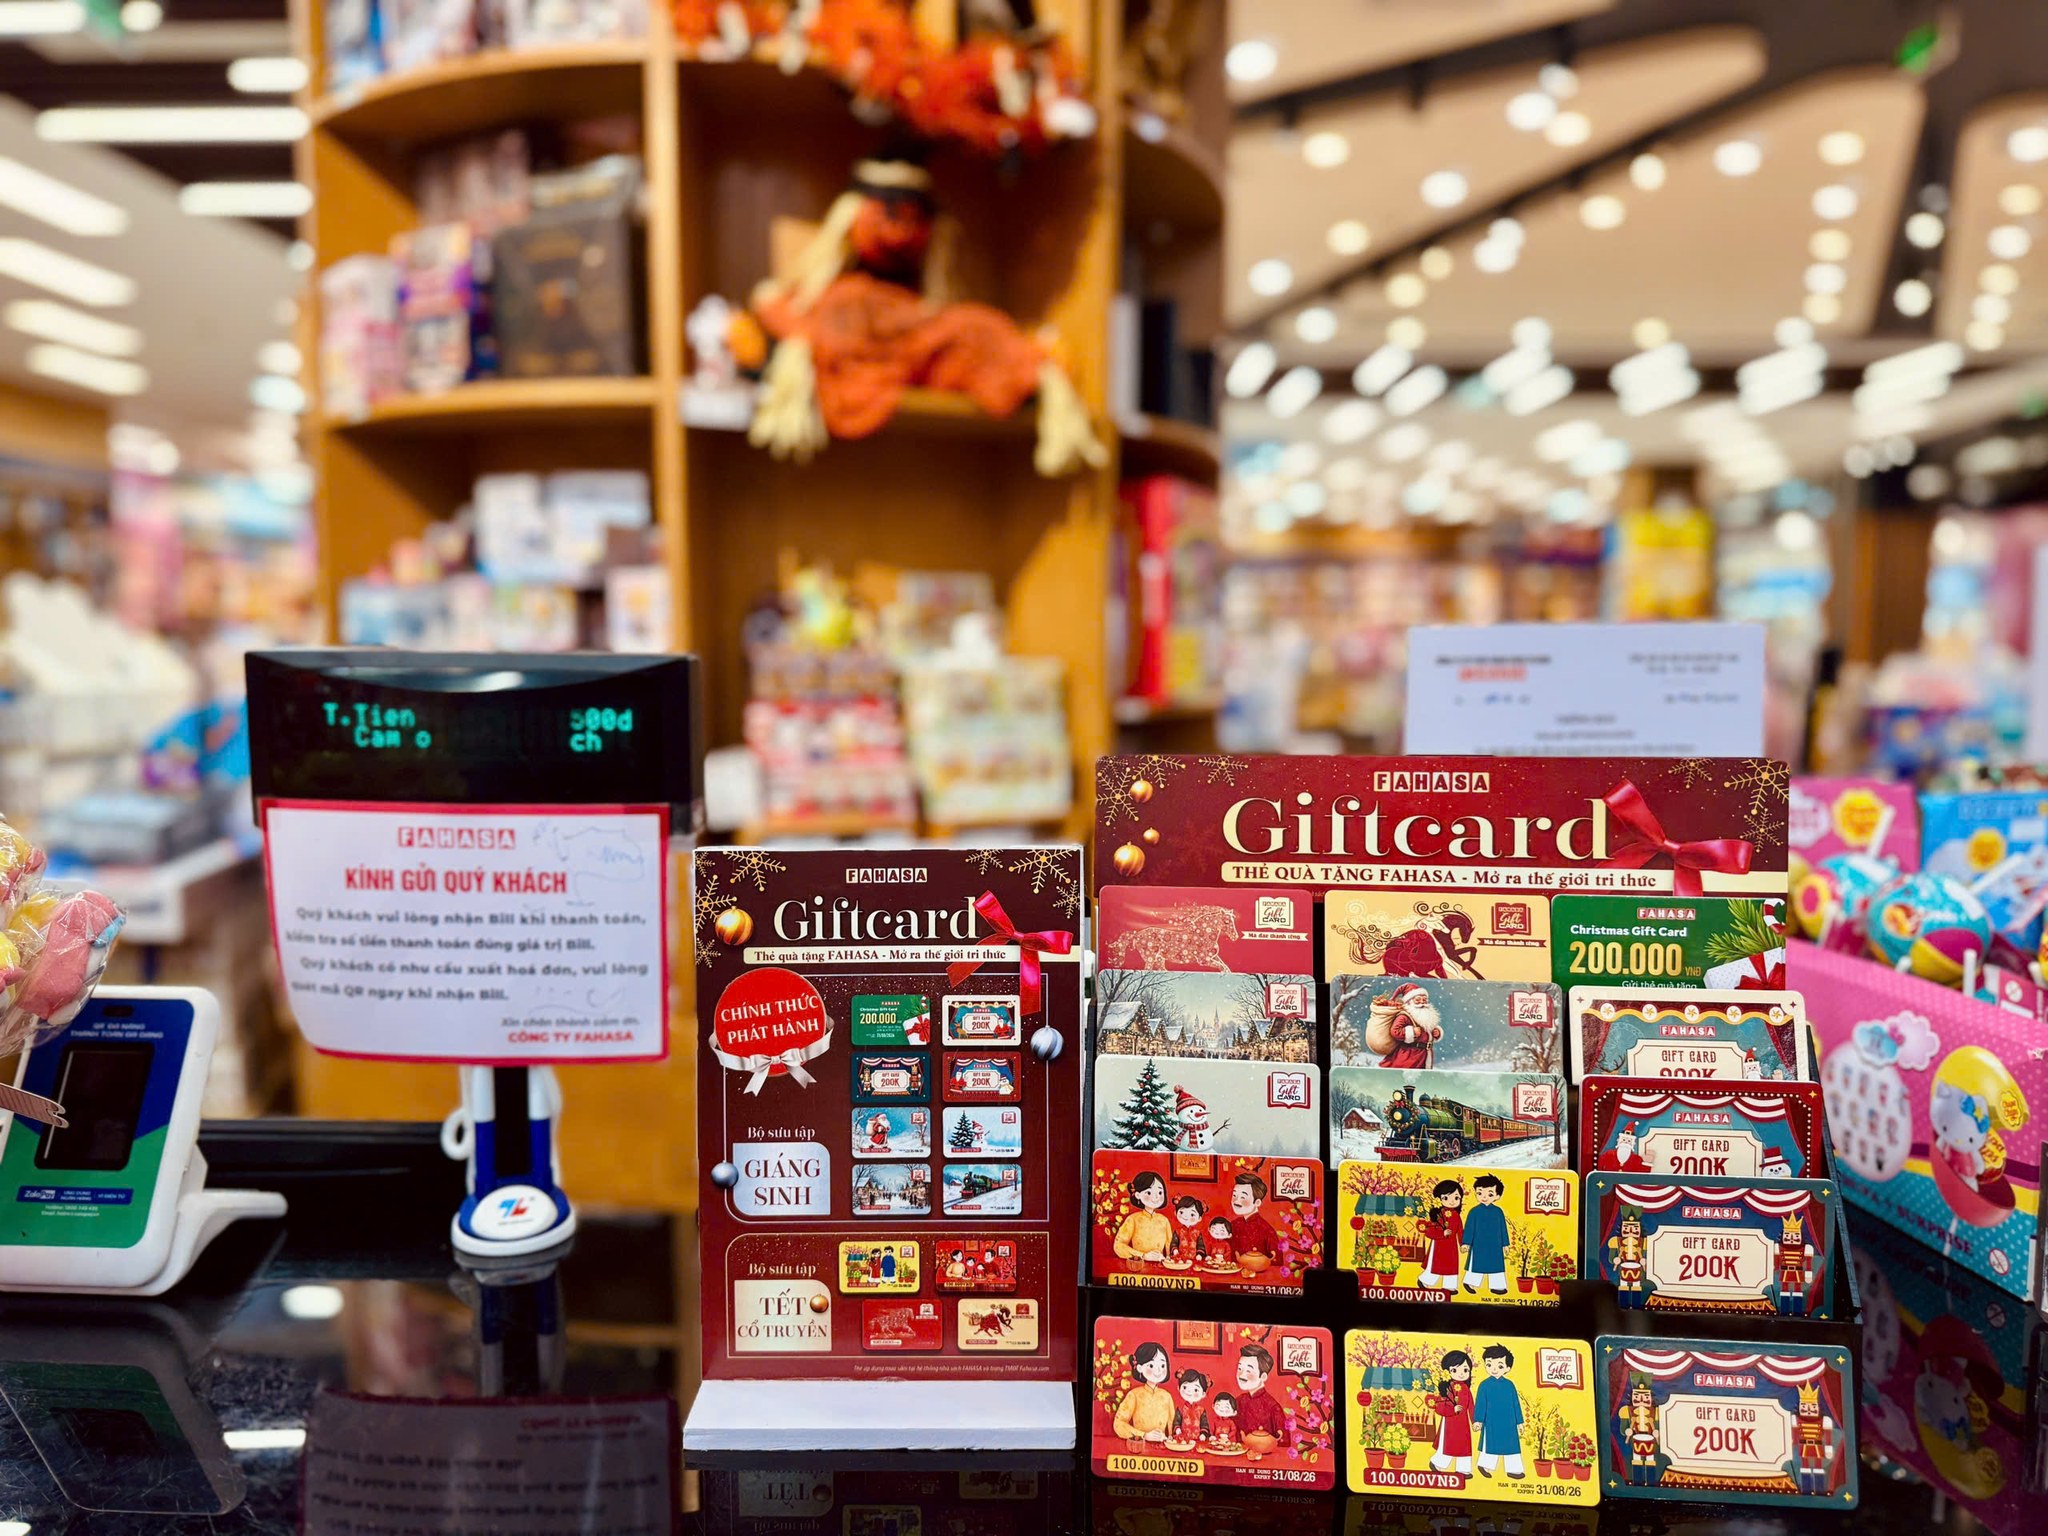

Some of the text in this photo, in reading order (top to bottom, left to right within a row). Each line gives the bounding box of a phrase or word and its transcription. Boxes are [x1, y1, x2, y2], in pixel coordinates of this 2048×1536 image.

[1374, 771, 1490, 792] FAHASA
[1223, 792, 1615, 860] Giftcard
[397, 827, 517, 849] FAHASA
[345, 862, 567, 894] KÍNH GỬI QUÝ KHÁCH
[846, 868, 927, 883] FAHASA
[1233, 863, 1656, 888] THẺ QUÀ TẶNG FAHASA Mở ra thế giới tri thức
[296, 907, 322, 922] Quý
[327, 907, 372, 922] khách
[377, 910, 399, 922] vui
[404, 910, 438, 926] lòng
[444, 912, 483, 926] nhận
[489, 913, 514, 925] Bill
[520, 912, 545, 925] khi
[551, 913, 599, 925] thanh
[773, 895, 980, 941] Giftcard
[1264, 907, 1283, 918] Gift
[1500, 912, 1522, 923] Gift
[1637, 907, 1696, 920] FAHASA
[1570, 924, 1687, 937] Christmas Gift Card
[391, 937, 433, 949] thanh
[437, 938, 470, 950] toán
[475, 938, 513, 952] đúng
[516, 938, 539, 951] giá
[566, 940, 595, 950] Bill.
[754, 950, 776, 960] Thẻ
[778, 950, 798, 962] quà
[801, 950, 825, 962] tặng
[827, 949, 879, 960] FAHASA
[889, 948, 907, 959] Mở
[924, 949, 942, 959] thế
[944, 949, 963, 961] giới
[967, 950, 979, 959] tri
[983, 949, 1006, 959] thức
[1569, 940, 1682, 976] 200.000
[300, 957, 325, 971] Quý
[330, 958, 374, 972] khách
[582, 963, 607, 975] vui
[612, 962, 649, 976] lòng
[368, 987, 404, 1000] ngay
[408, 986, 432, 999] khi
[436, 988, 474, 1002] nhận
[480, 989, 509, 1000] Bill.
[1276, 994, 1296, 1005] Gift
[721, 993, 819, 1022] CHÍNH THỨC
[1520, 1003, 1540, 1014] Gift
[860, 1013, 896, 1024] 200.000
[727, 1018, 819, 1044] PHÁT HÀNH
[972, 1022, 992, 1031] 200K
[1660, 1025, 1716, 1037] FAHASA
[508, 1030, 634, 1043] CÔNG TY FAHASA
[1662, 1050, 1716, 1063] GIFT CARD
[881, 1078, 900, 1087] 200K
[972, 1078, 991, 1087] 200K
[1278, 1084, 1299, 1095] Gift
[1524, 1096, 1545, 1107] Gift
[1673, 1112, 1731, 1125] FAHASA
[748, 1125, 815, 1141] Bộ sưu tập
[1673, 1139, 1729, 1152] GIFT CARD
[745, 1152, 820, 1178] GIÁNG
[1282, 1178, 1303, 1189] Gift
[754, 1186, 811, 1206] SINH
[1536, 1190, 1558, 1201] Gift
[1682, 1206, 1741, 1220] FAHASA
[1682, 1237, 1740, 1250] GIFT CARD
[749, 1262, 816, 1277] Bộ sưu tập
[1679, 1254, 1741, 1285] 200K
[759, 1288, 807, 1315] TẾT
[1361, 1288, 1446, 1302] 100.000VNĐ
[738, 1319, 827, 1337] CỔ TRUYỀN
[1289, 1349, 1310, 1362] Gift
[1548, 1361, 1569, 1374] Gift
[1694, 1373, 1755, 1389] FAHASA
[1696, 1407, 1756, 1422] GIFT CARD
[1693, 1426, 1760, 1460] 200K
[1113, 1458, 1199, 1473] 100.000VNĐ
[1272, 1469, 1316, 1482] 31/08/26
[1371, 1470, 1459, 1487] 100.000VNĐ
[1536, 1484, 1582, 1496] 31/08/26
